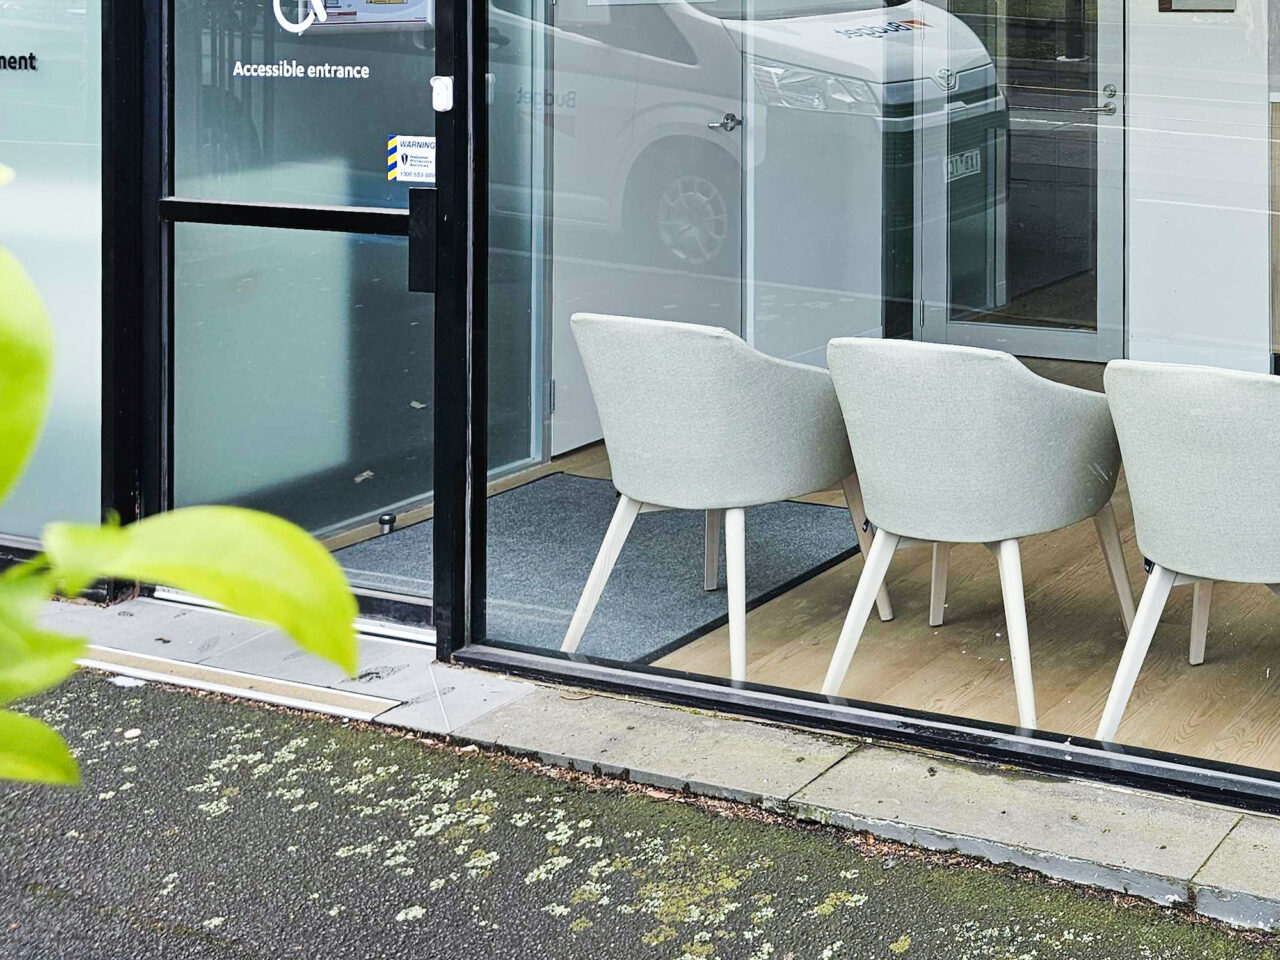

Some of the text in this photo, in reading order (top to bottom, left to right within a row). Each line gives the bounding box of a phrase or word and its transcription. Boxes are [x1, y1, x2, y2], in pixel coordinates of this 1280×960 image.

[232, 59, 370, 79] Accessible entrance
[400, 140, 436, 150] WARNING
